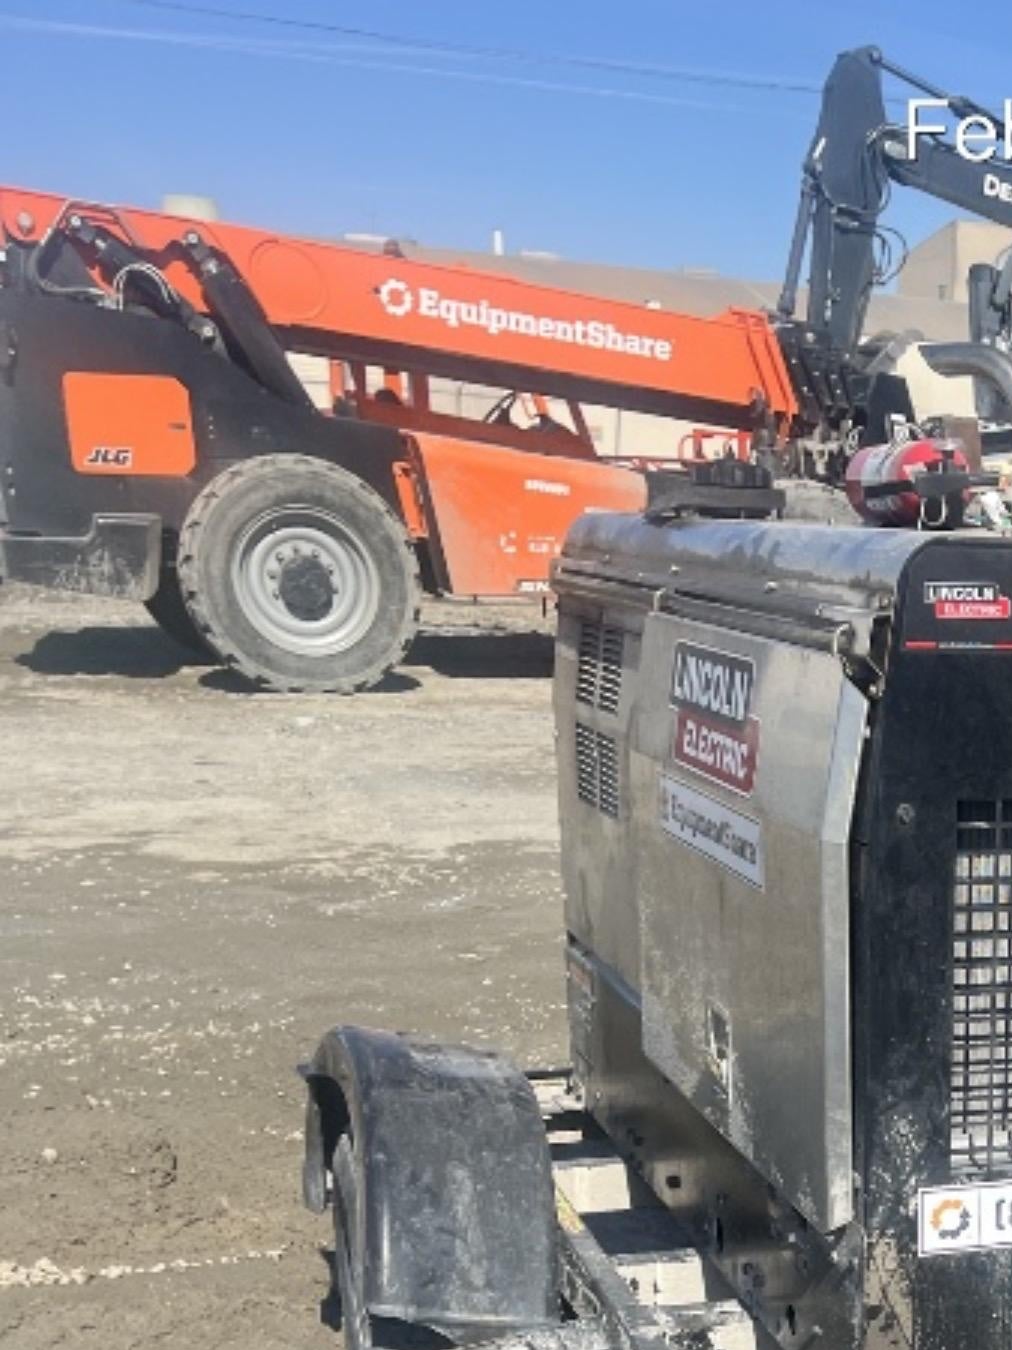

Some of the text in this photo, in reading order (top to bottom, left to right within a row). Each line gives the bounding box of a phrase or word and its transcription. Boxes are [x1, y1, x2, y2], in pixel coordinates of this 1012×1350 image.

[418, 286, 673, 360] EquipmentShare
[86, 447, 132, 467] JLG
[929, 585, 994, 601] LINCOLN
[673, 651, 749, 723] LINCOLN
[682, 718, 750, 780] ELECTRIC
